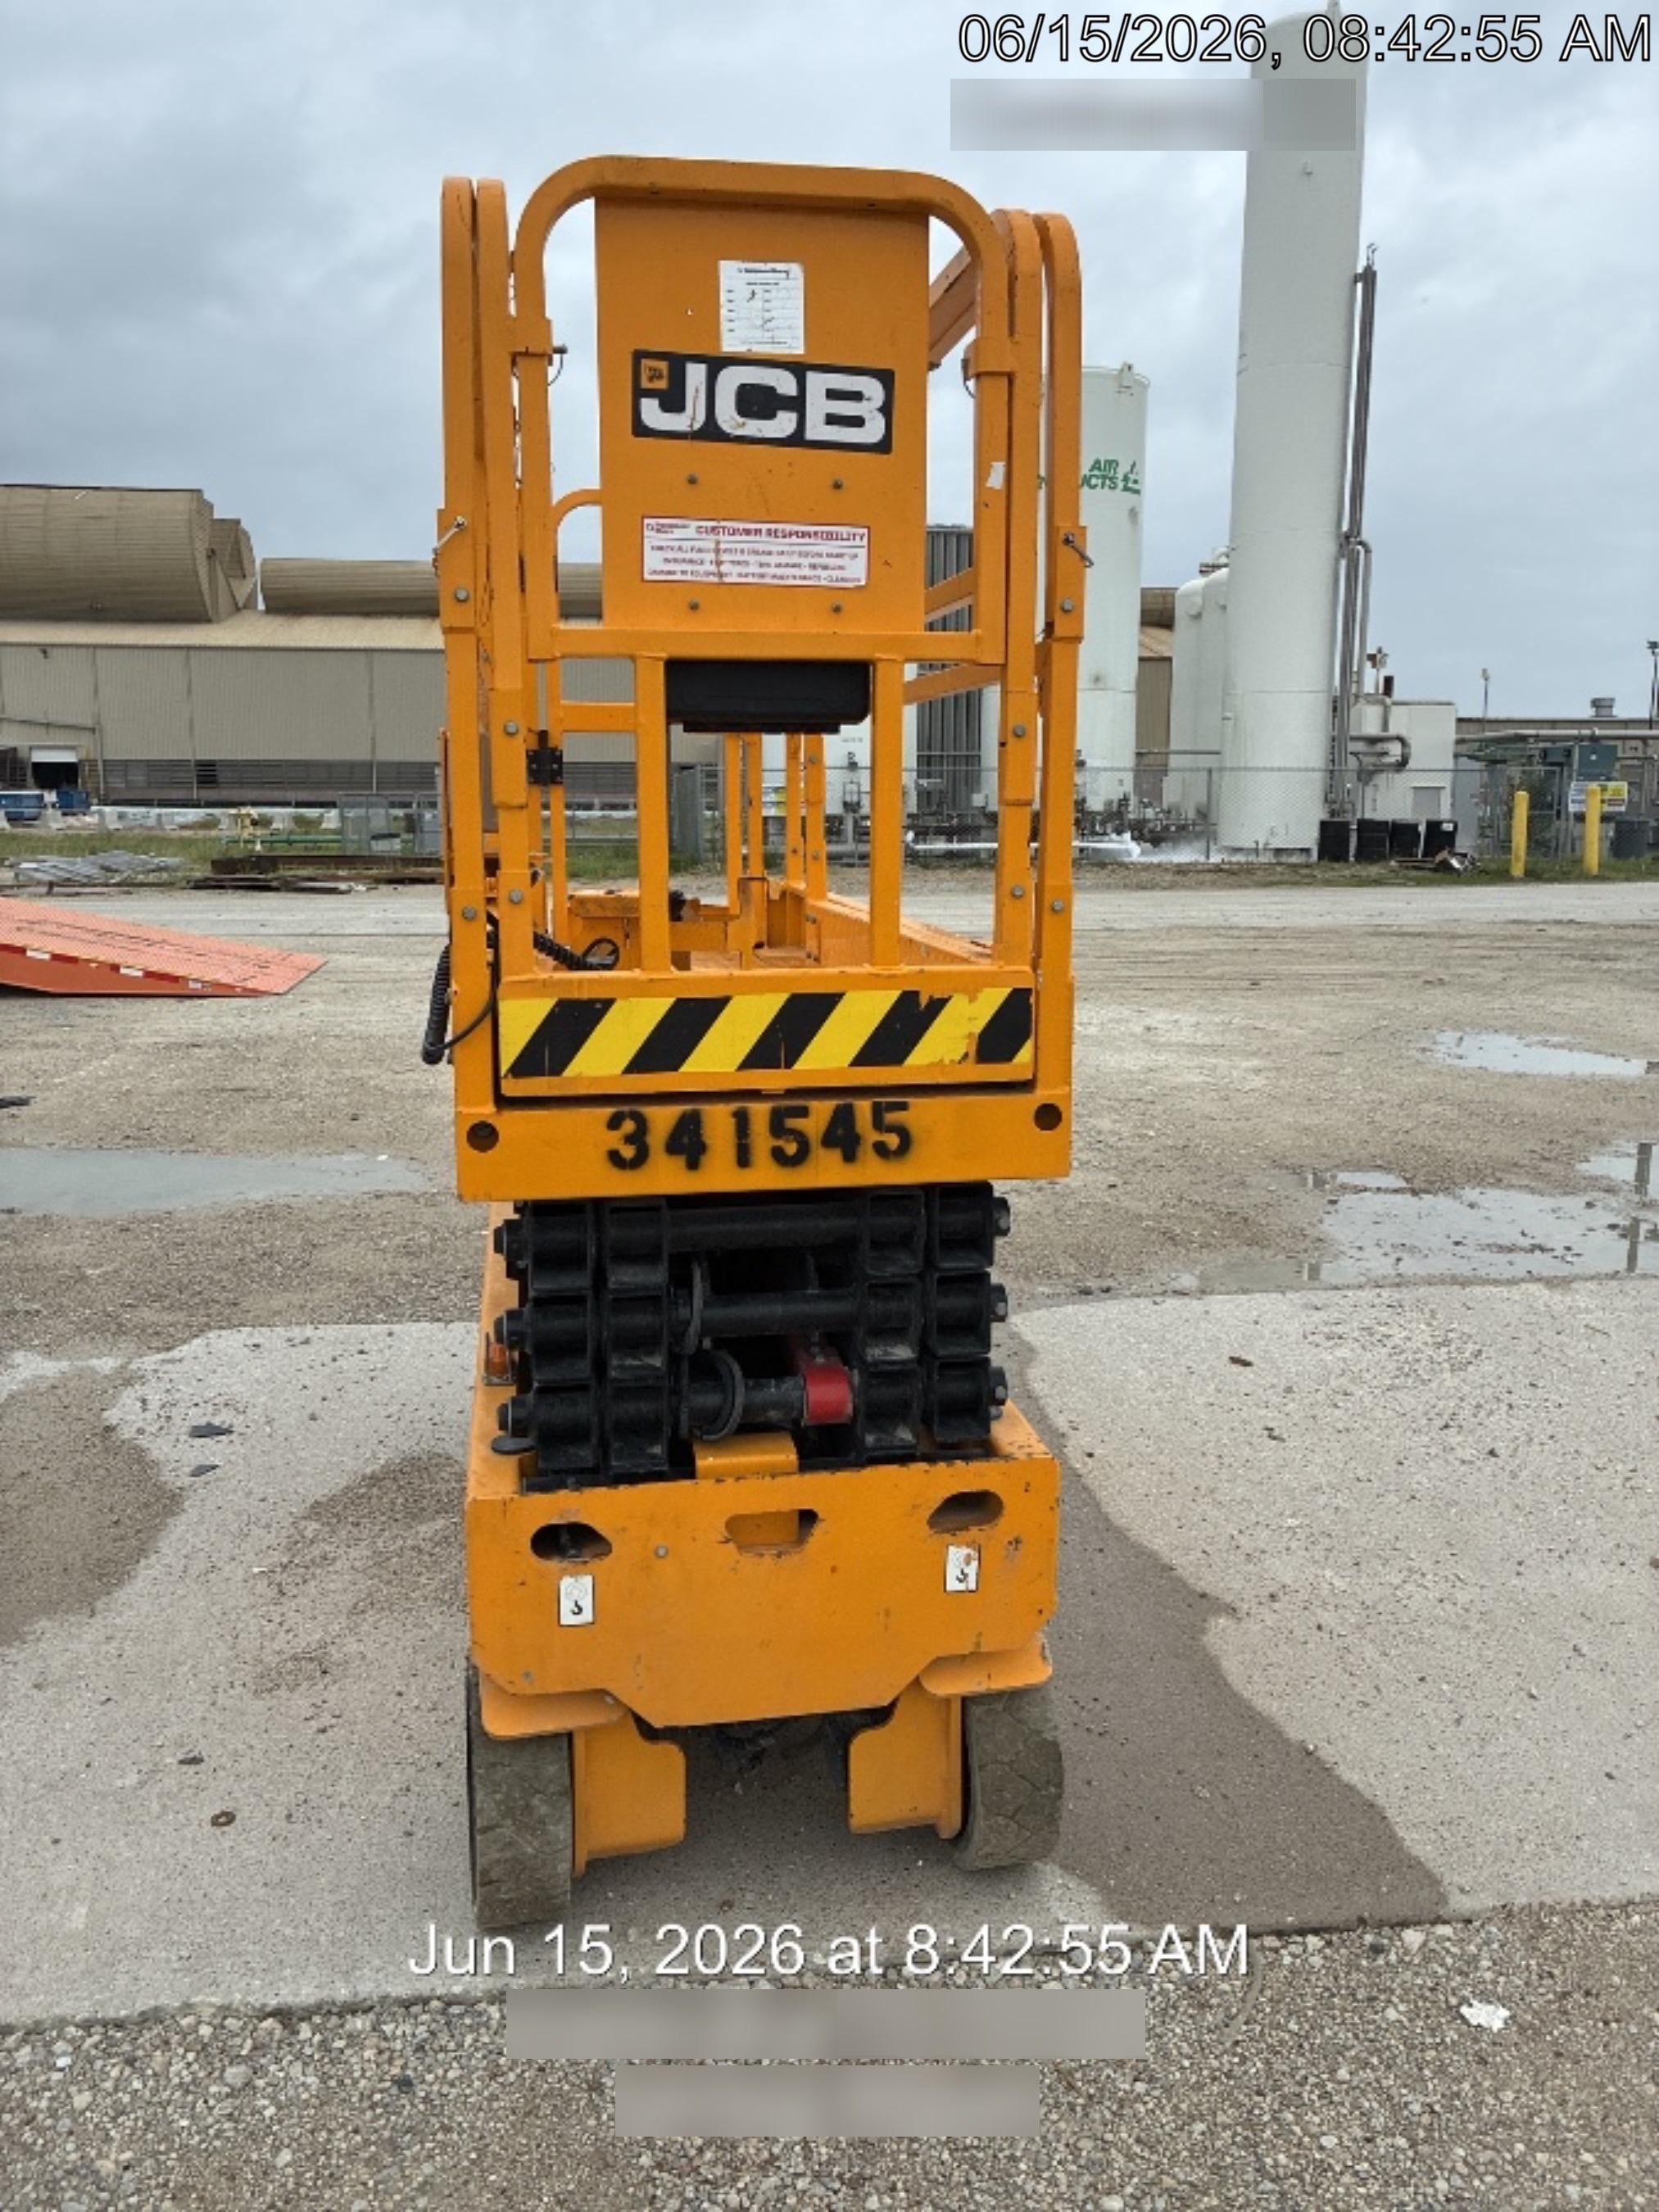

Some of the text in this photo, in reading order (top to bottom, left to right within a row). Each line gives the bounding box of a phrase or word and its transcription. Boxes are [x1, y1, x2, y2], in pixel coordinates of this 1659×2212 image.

[640, 361, 886, 444] JCB
[1088, 456, 1119, 475] AIR
[695, 525, 763, 538] CUSTOMER
[765, 528, 866, 542] RESPONSIBILITY
[605, 1099, 912, 1171] 341545
